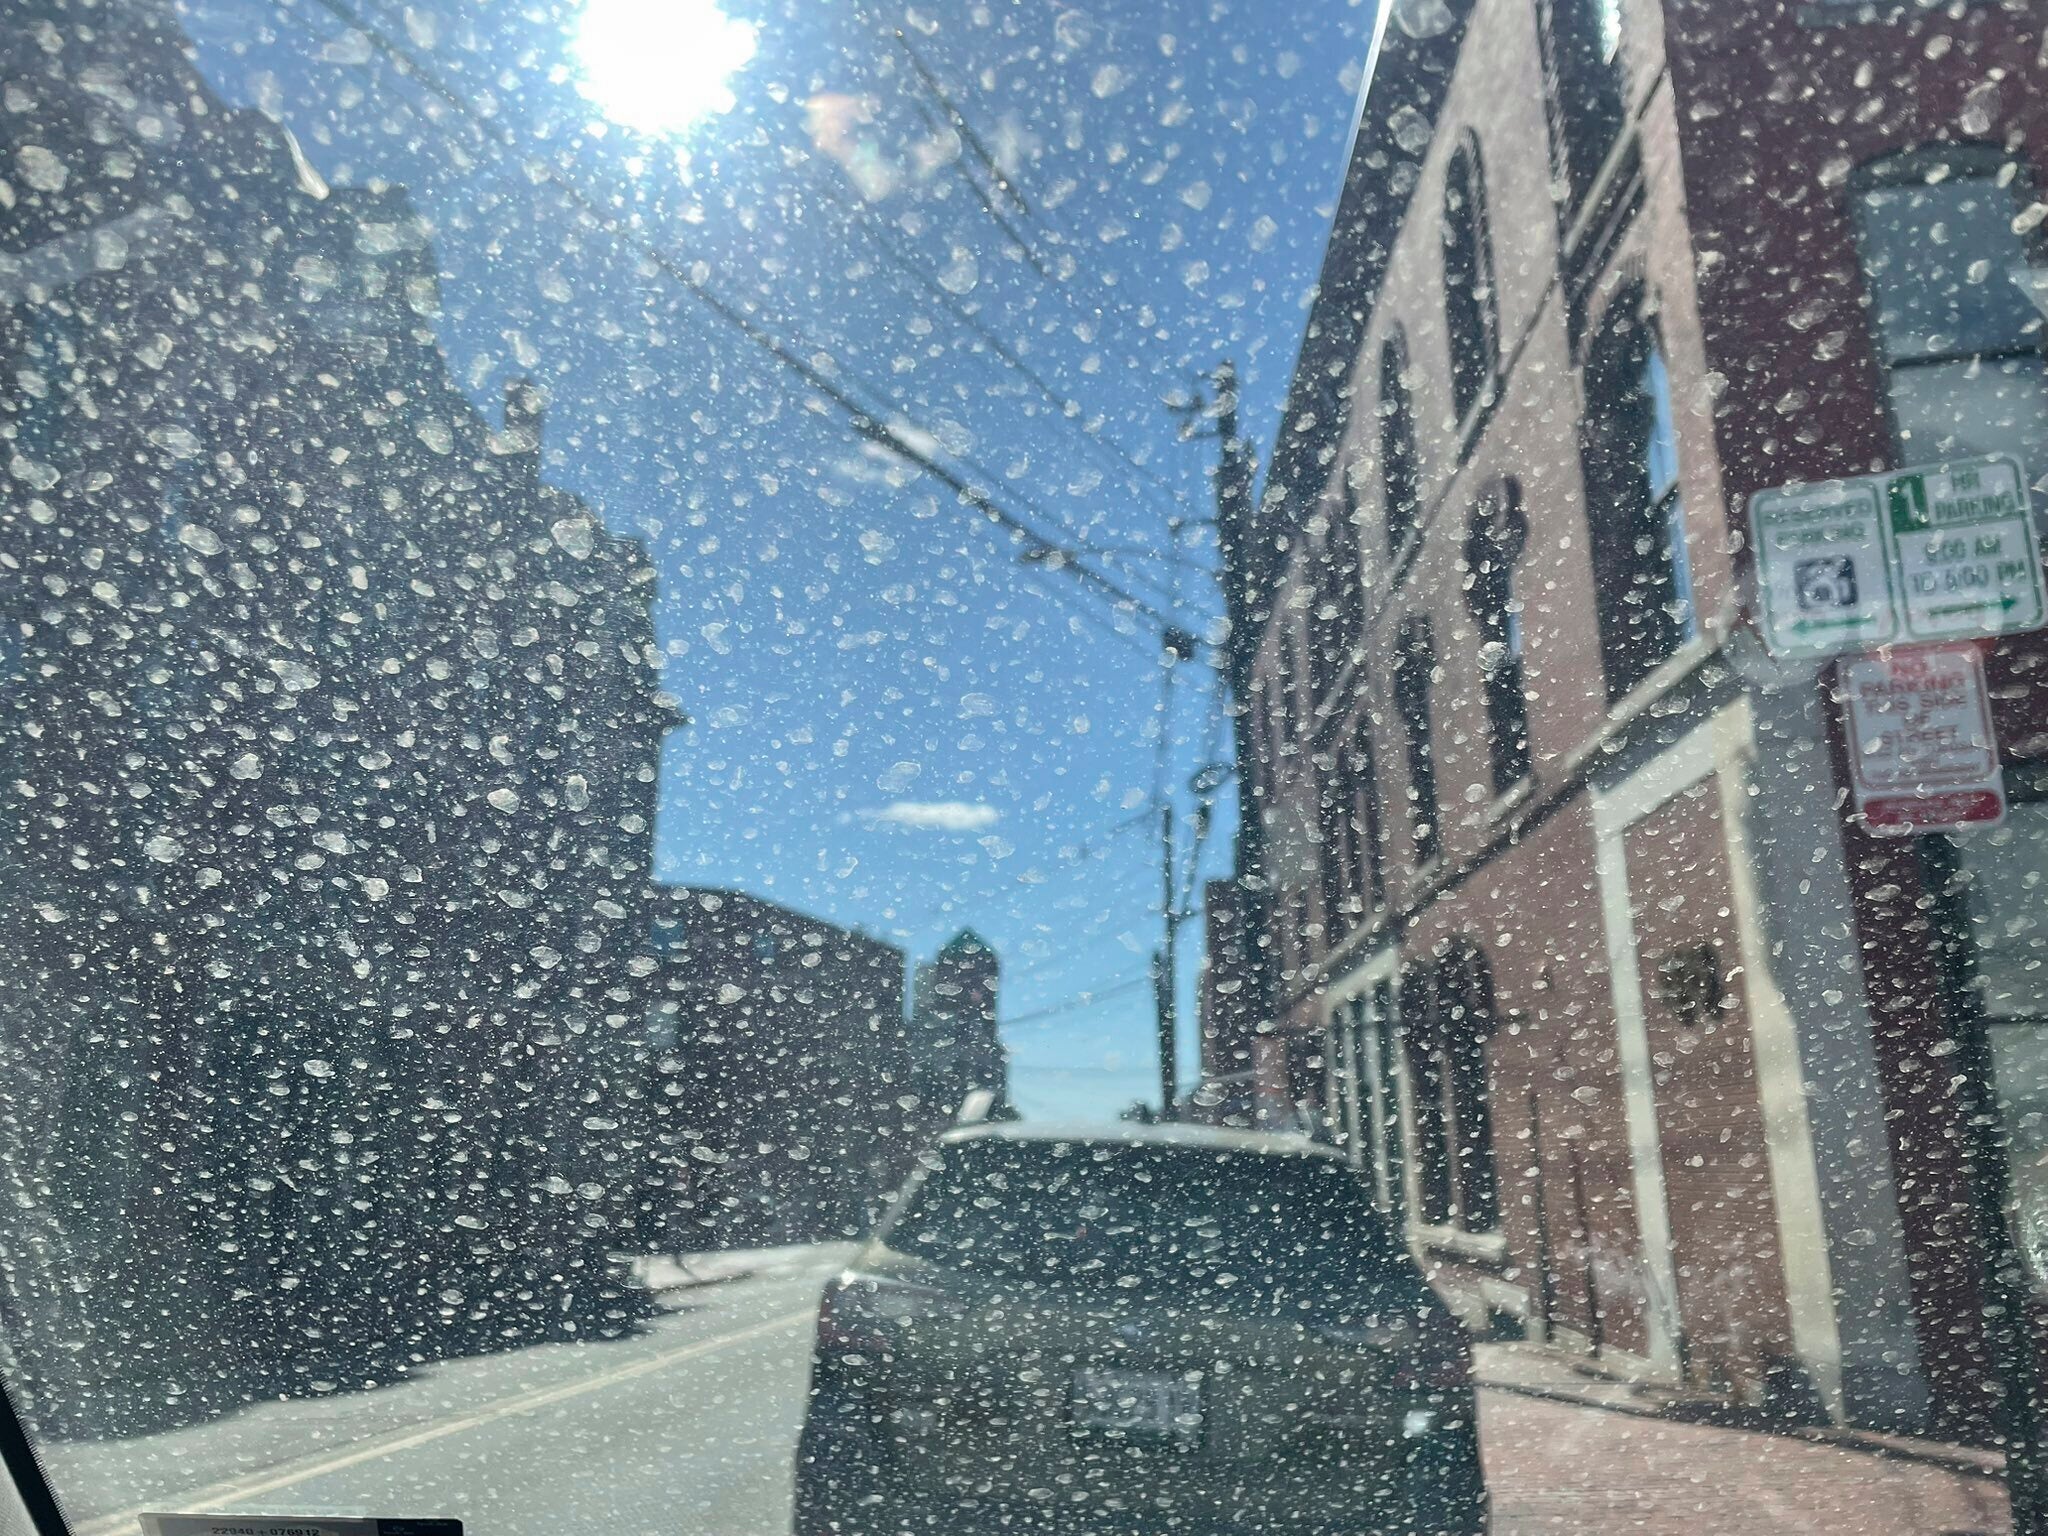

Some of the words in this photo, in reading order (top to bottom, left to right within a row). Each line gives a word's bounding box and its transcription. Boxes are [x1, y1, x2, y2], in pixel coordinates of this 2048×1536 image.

[1935, 491, 2015, 519] PARKING
[1975, 534, 2001, 556] AM
[1997, 558, 2027, 582] PM
[1891, 657, 1927, 677] NO
[1860, 672, 1966, 694] PARKING
